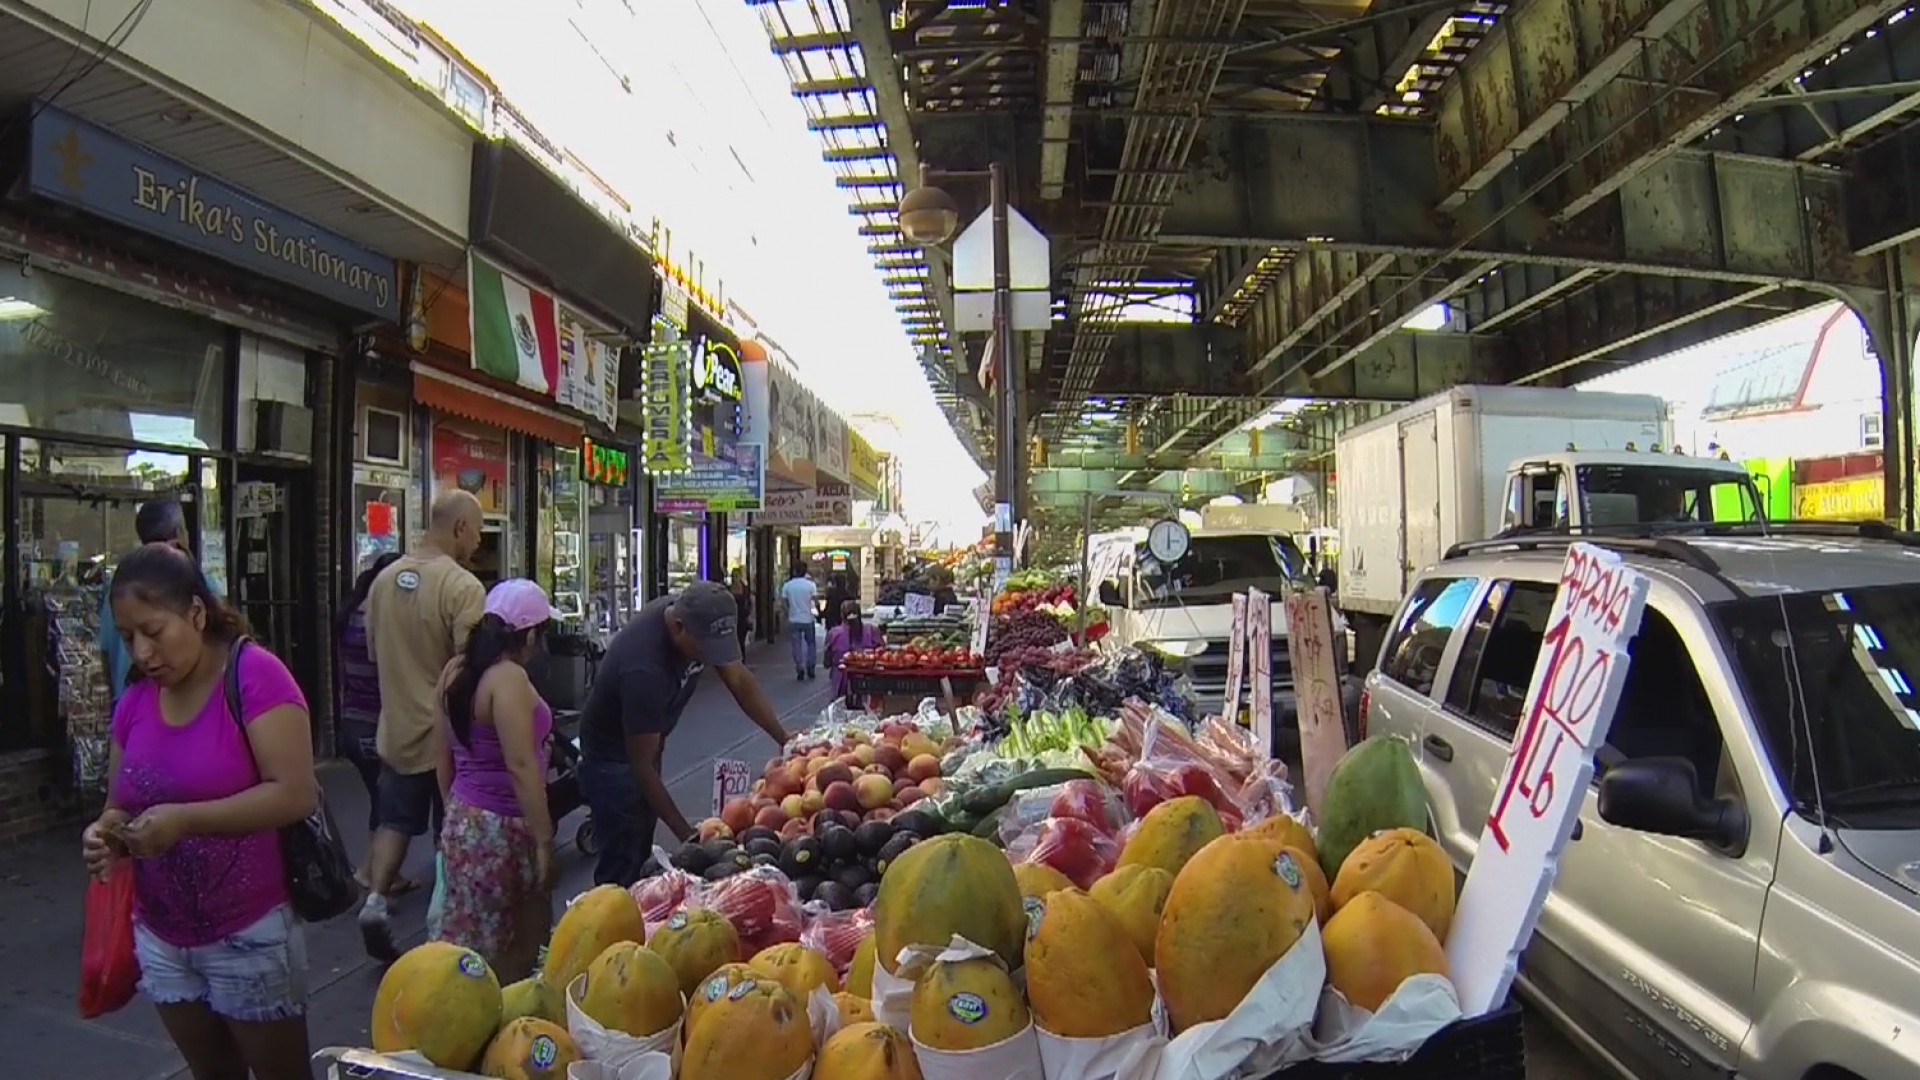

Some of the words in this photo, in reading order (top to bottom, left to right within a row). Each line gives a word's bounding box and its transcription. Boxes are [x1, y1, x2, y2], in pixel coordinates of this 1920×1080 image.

[132, 165, 244, 243] Erika's
[253, 217, 389, 309] Stationary
[1561, 549, 1630, 634] PAPAYA
